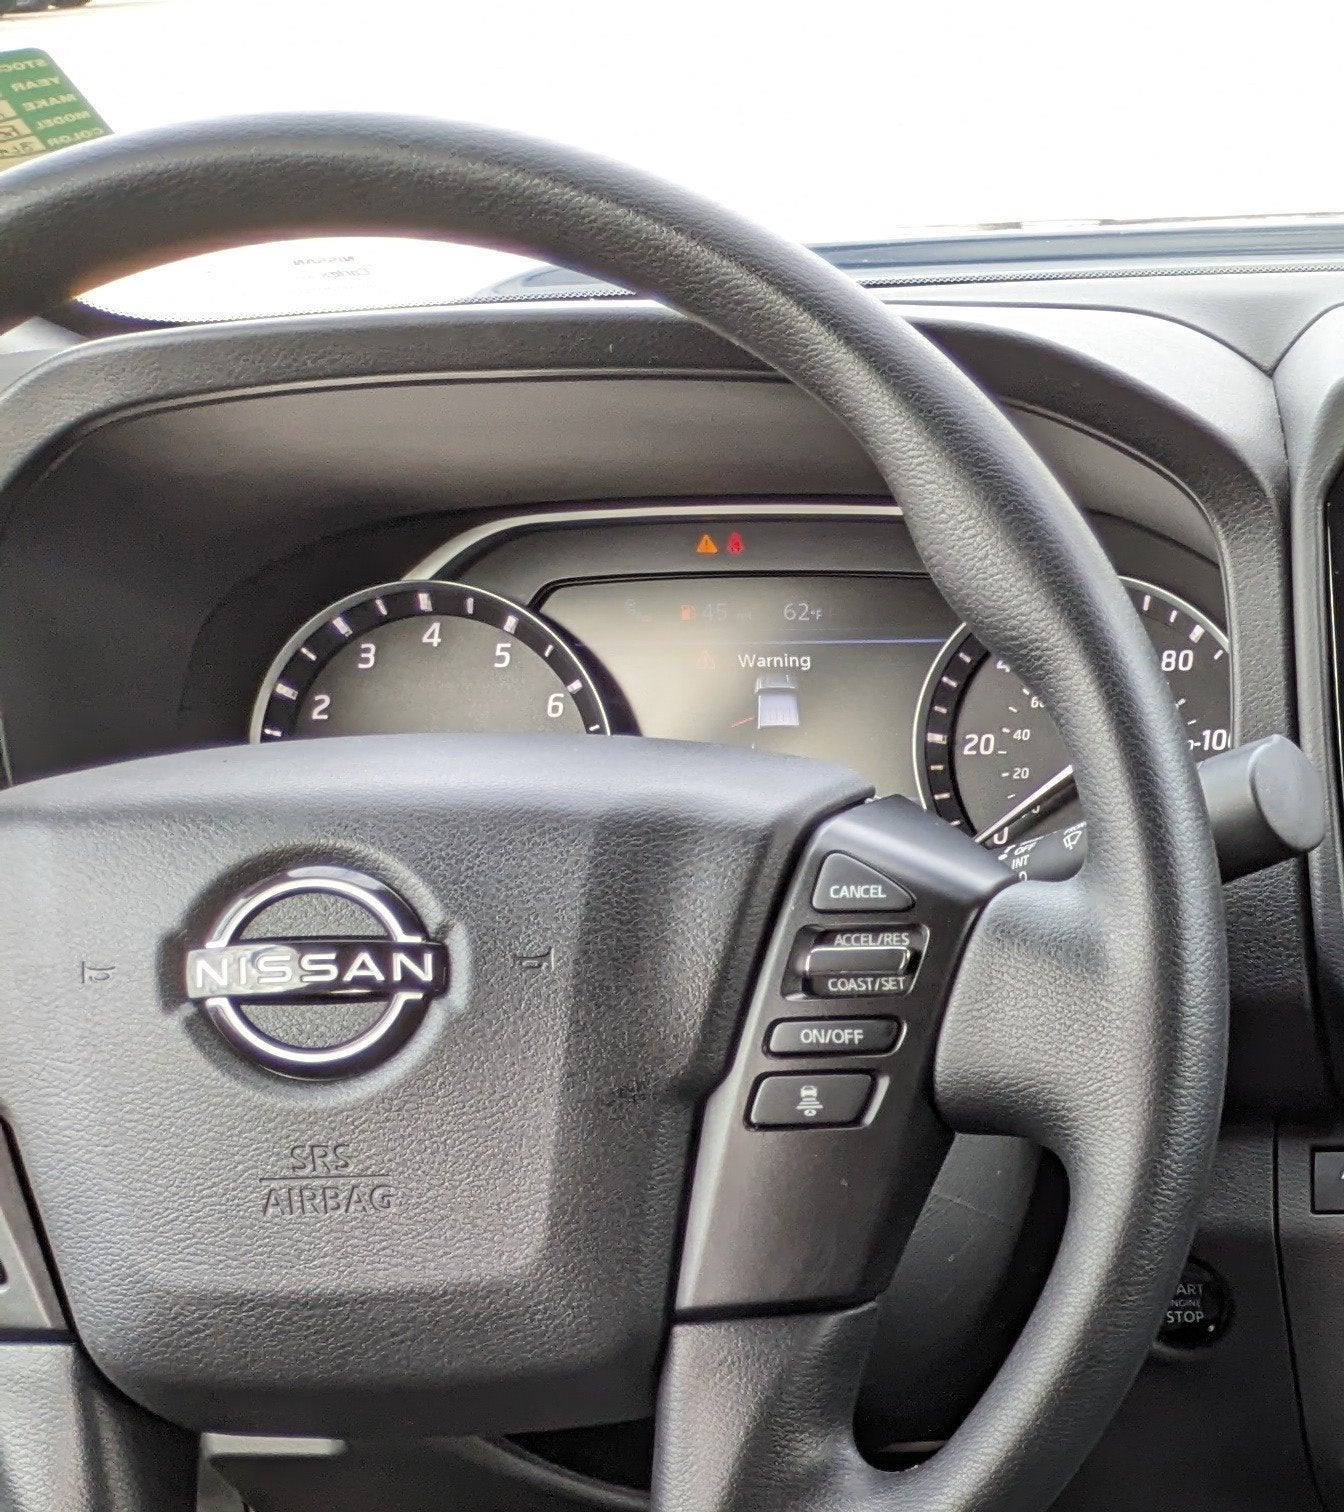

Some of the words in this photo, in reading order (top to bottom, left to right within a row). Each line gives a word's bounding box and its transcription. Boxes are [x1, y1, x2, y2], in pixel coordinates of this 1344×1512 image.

[421, 622, 442, 648] 4
[357, 644, 377, 668] 3
[493, 644, 512, 668] 5
[737, 653, 811, 671] Warning
[1161, 649, 1194, 672] 80
[311, 695, 332, 720] 2
[546, 694, 565, 718] 6
[963, 733, 995, 756] 20
[1012, 728, 1031, 741] 40
[1012, 767, 1030, 779] 20
[1011, 854, 1030, 870] INT
[830, 884, 887, 899] CANCEL
[834, 932, 910, 947] ACCEL/RES
[195, 950, 434, 987] NISSAN
[827, 977, 906, 992] COAST/SET
[800, 1029, 864, 1045] ON/OFF
[289, 1143, 351, 1172] SRS
[260, 1184, 394, 1219] AIRBAG
[1166, 1310, 1205, 1324] STOP
